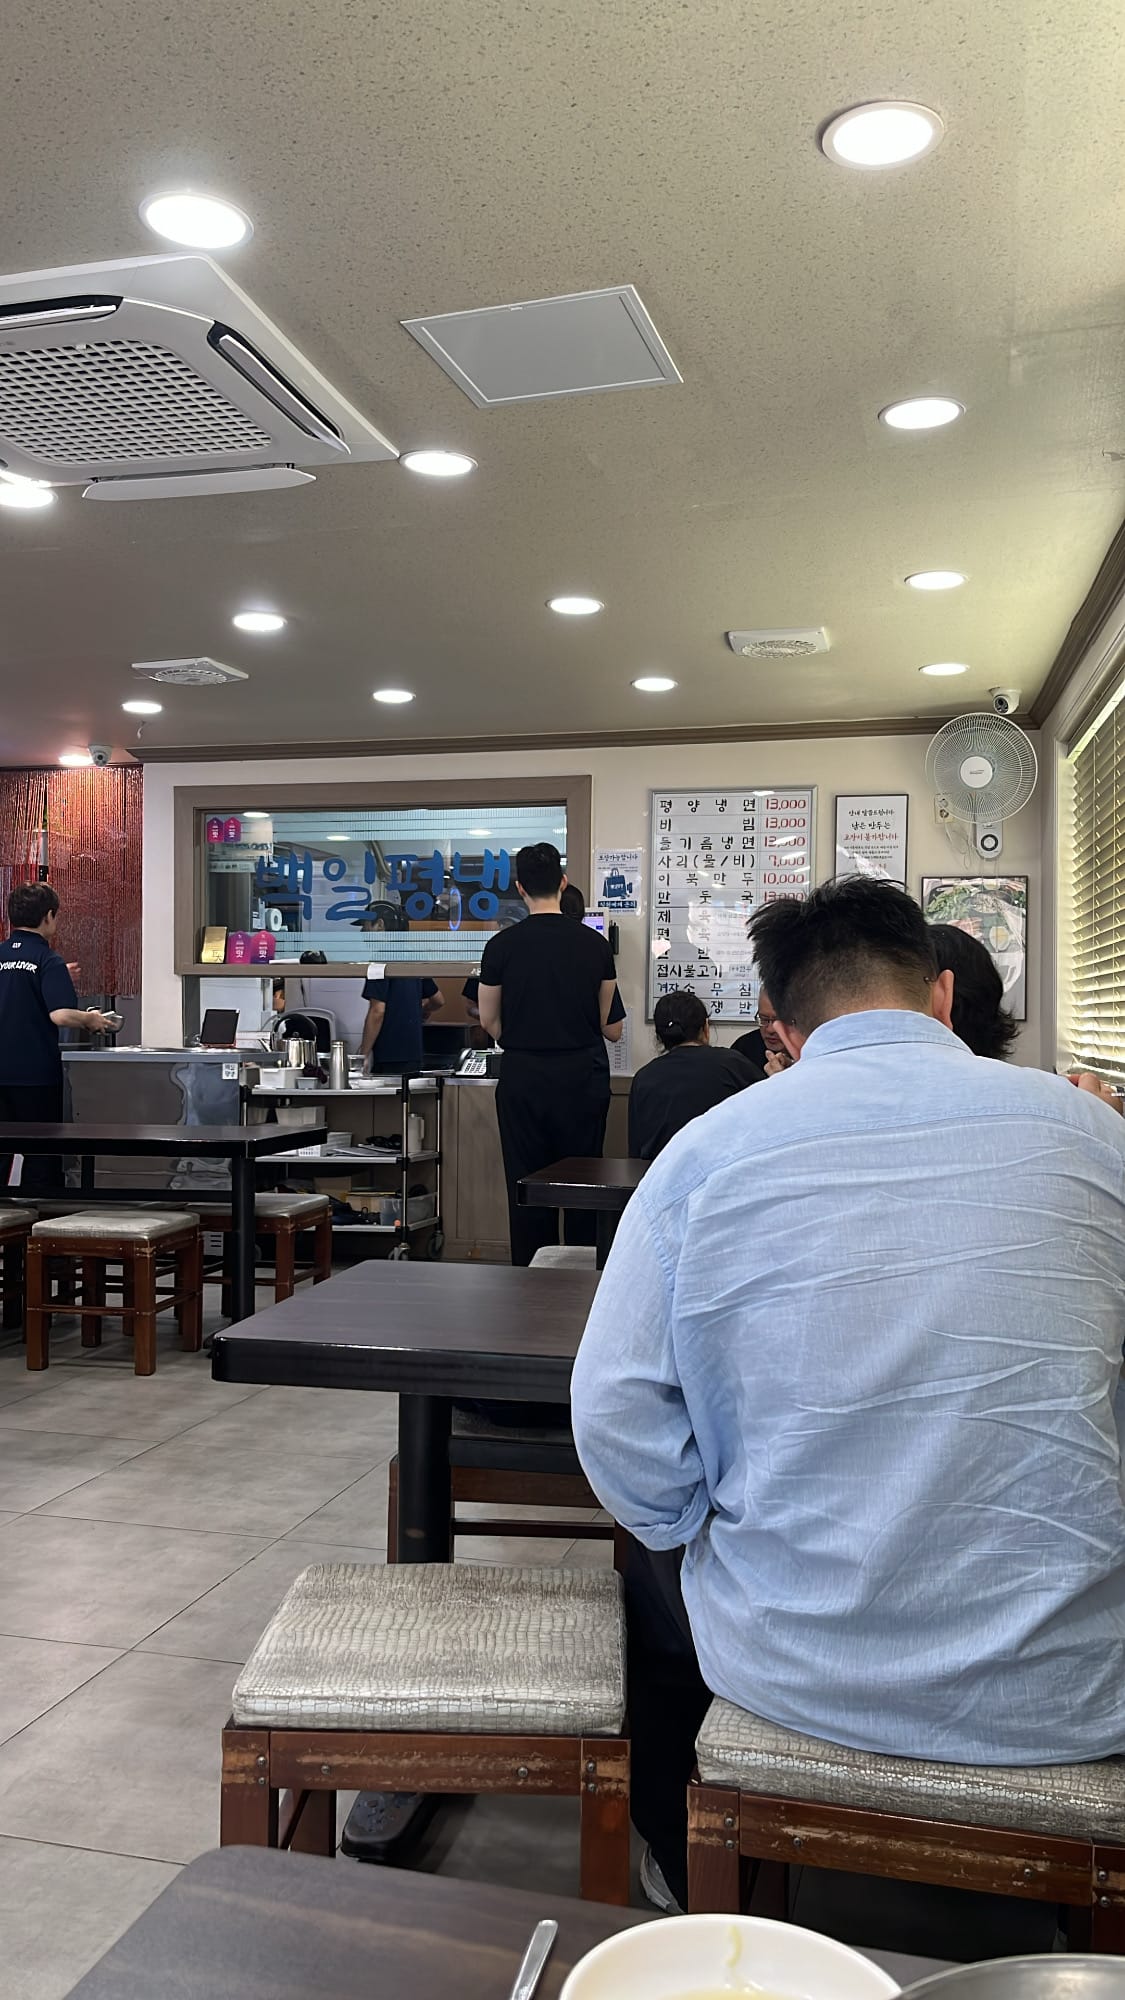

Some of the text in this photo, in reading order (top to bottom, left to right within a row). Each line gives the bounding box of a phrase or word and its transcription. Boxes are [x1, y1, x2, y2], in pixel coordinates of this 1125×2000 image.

[767, 799, 806, 811] 13,000
[766, 817, 806, 829] 13,000
[769, 855, 805, 867] 7,000
[256, 849, 510, 921] 백일평냉
[763, 873, 805, 886] 10,000
[764, 891, 805, 902] 13000
[657, 964, 723, 978] 접시불고기
